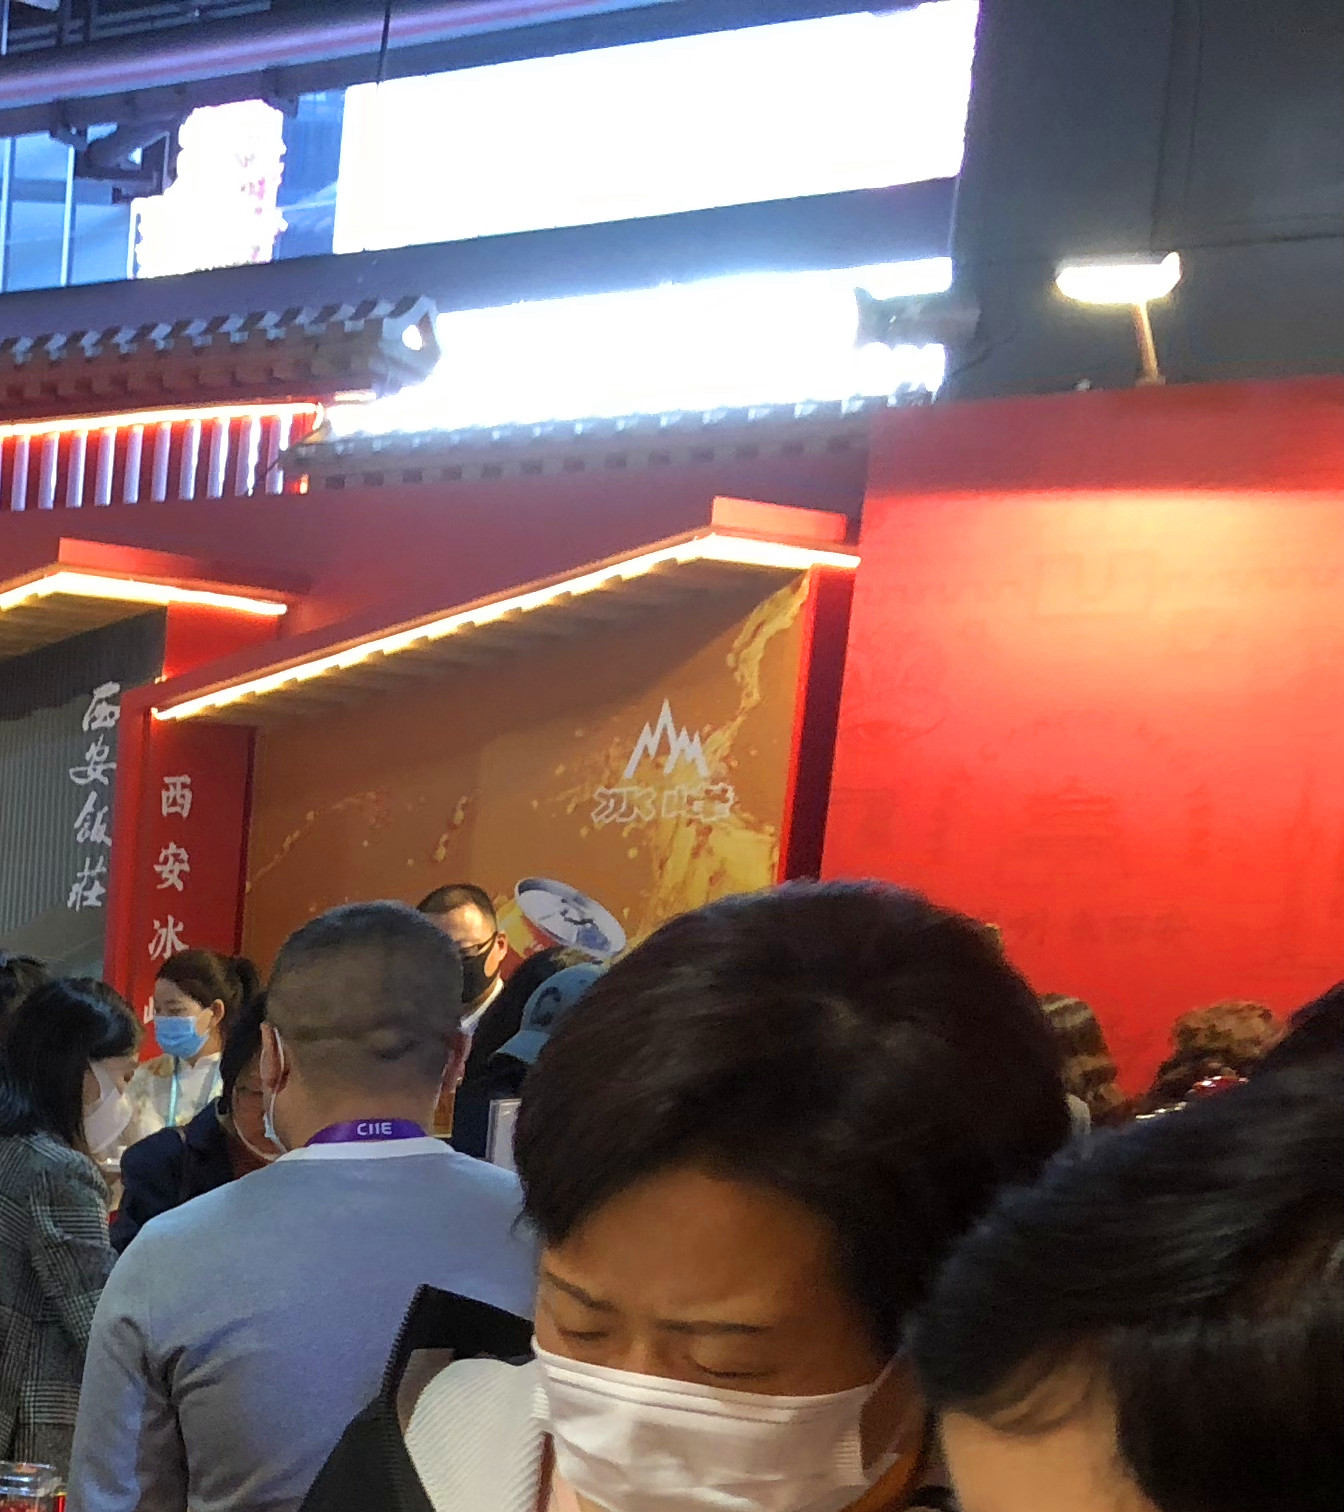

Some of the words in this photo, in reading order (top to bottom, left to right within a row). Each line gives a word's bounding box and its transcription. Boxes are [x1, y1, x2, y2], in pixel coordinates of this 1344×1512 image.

[144, 774, 193, 1025] 西安冰
[356, 1122, 393, 1135] CIIE
